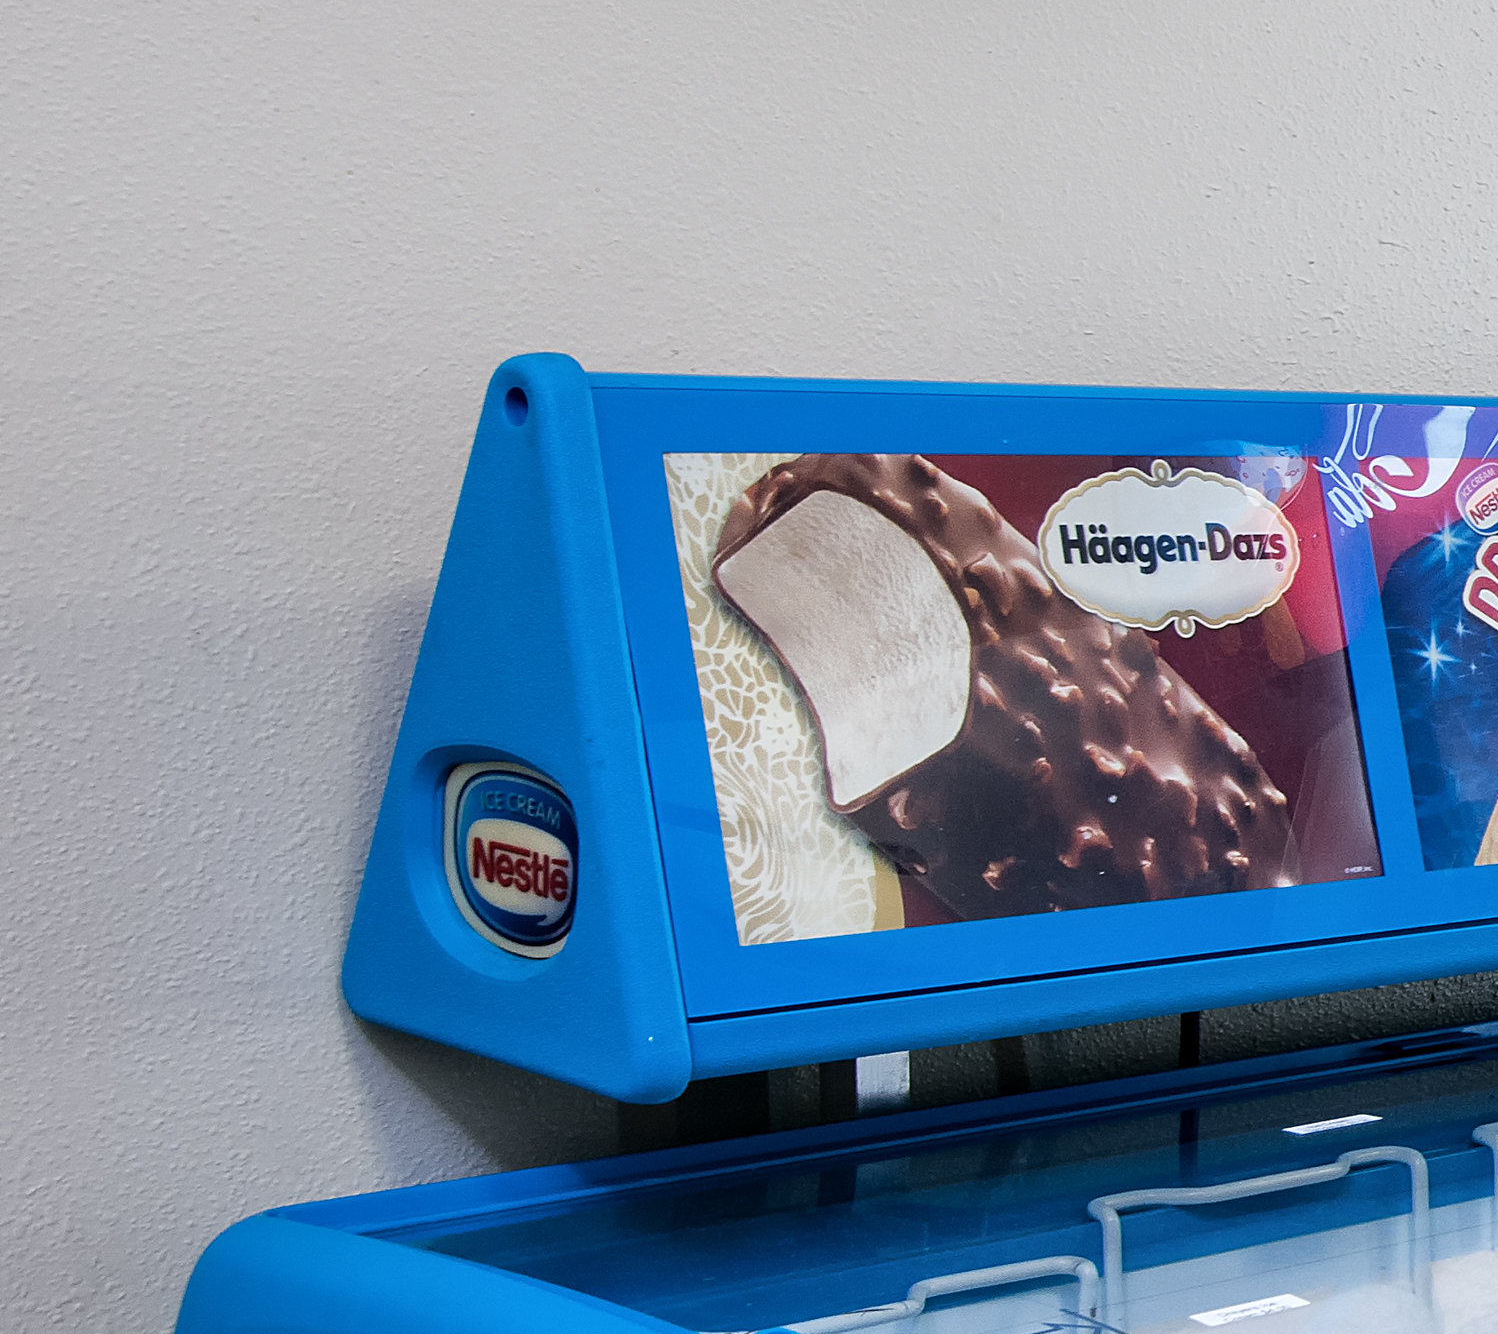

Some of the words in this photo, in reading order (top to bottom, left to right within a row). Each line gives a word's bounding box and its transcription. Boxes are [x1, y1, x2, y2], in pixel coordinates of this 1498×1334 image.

[1461, 484, 1475, 499] ICE
[1472, 468, 1496, 490] CREAM
[1059, 522, 1288, 575] Häagen-Dazs
[480, 790, 504, 812] ICE
[507, 795, 561, 830] CREAM
[472, 837, 569, 902] Nestlé
